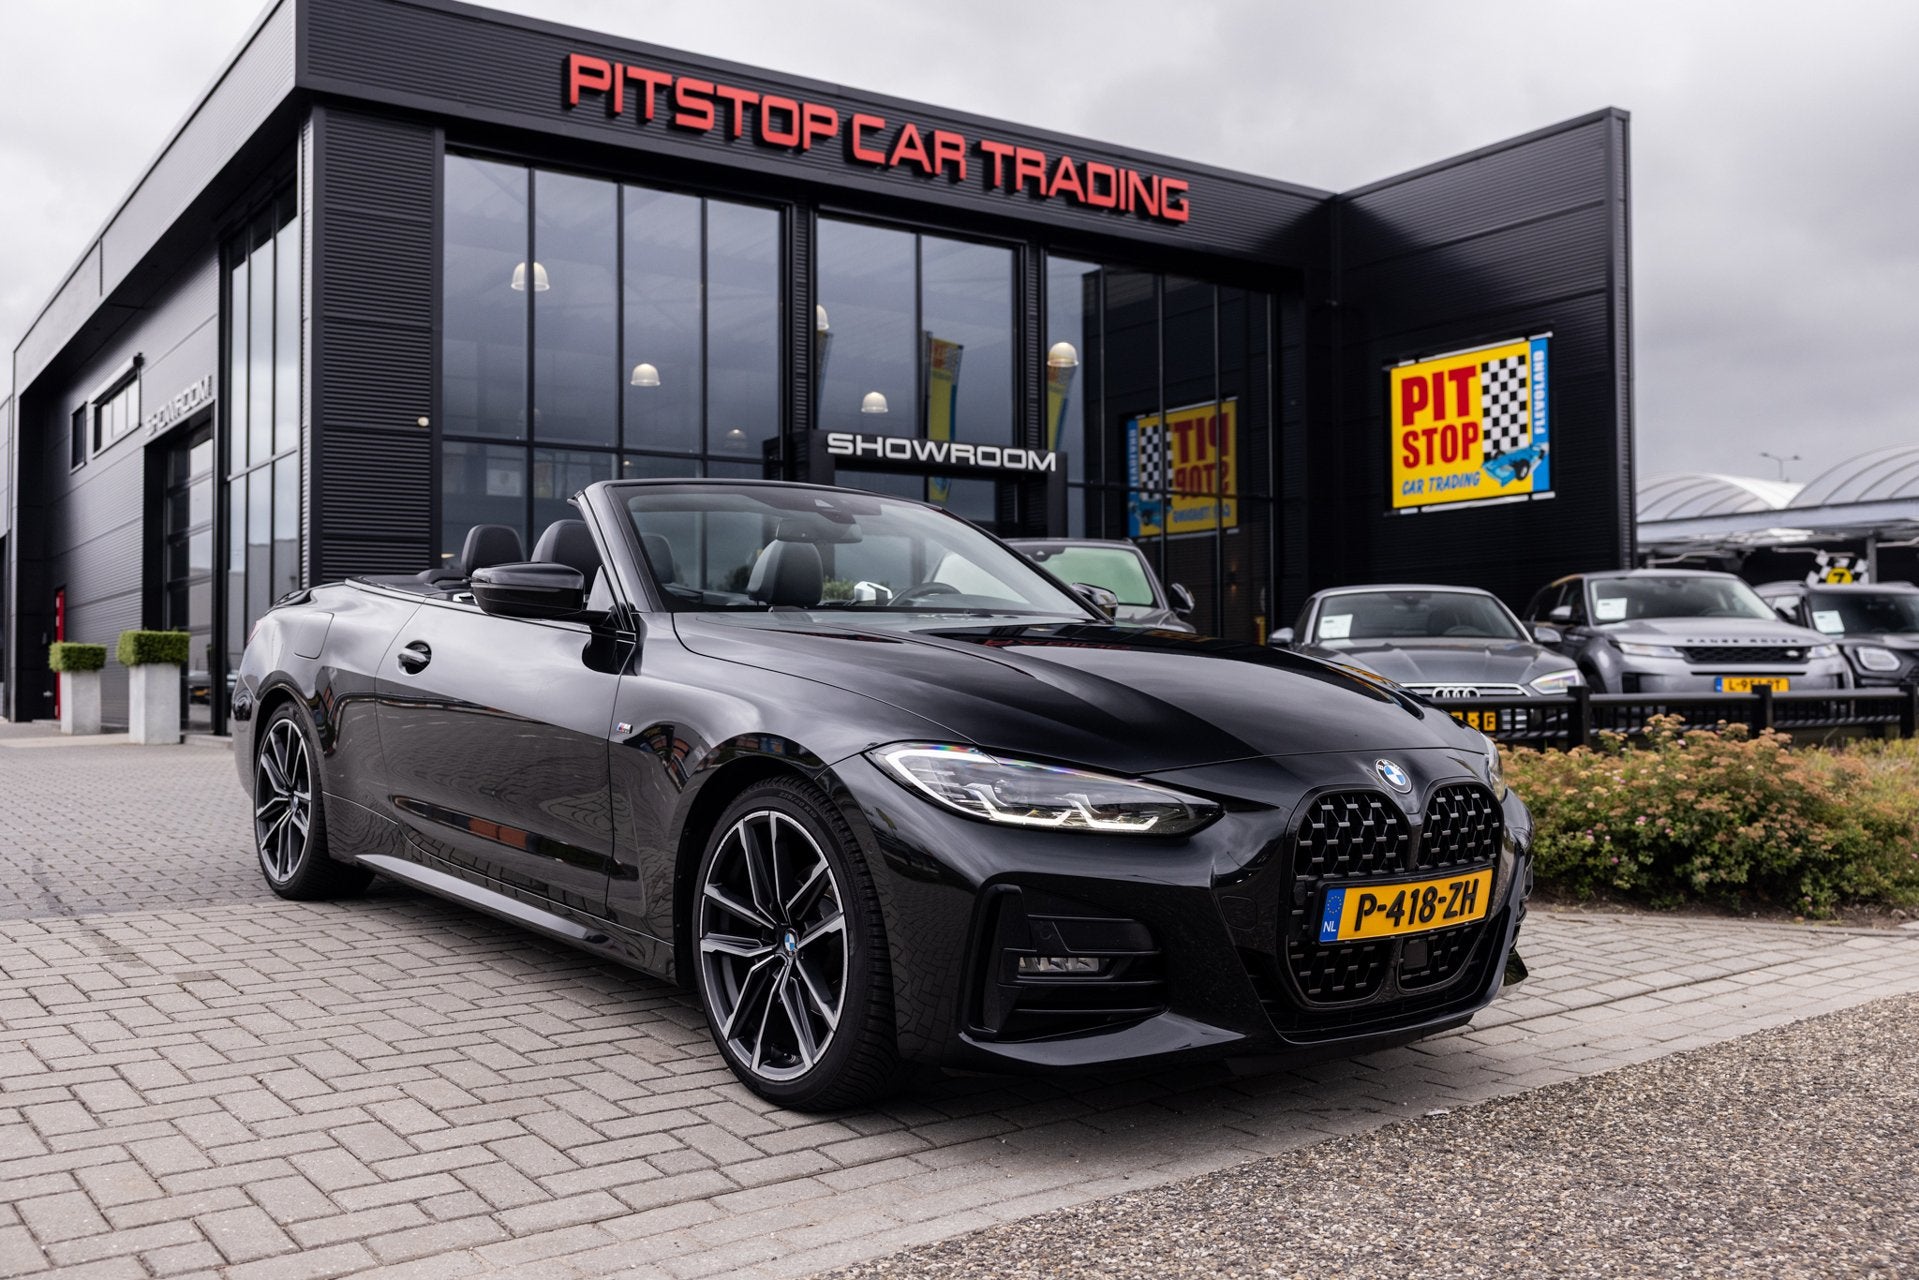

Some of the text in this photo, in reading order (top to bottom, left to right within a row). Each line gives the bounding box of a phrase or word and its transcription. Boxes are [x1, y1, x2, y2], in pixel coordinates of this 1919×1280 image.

[567, 53, 1190, 224] PITSTOP CAR TRADING
[1401, 365, 1477, 427] PIT
[1532, 350, 1546, 435] FLEVOLAND
[826, 432, 1057, 472] SHOWROOM
[1402, 421, 1479, 469] STOP
[1402, 471, 1481, 496] CAR TRADING
[1322, 920, 1337, 933] NL
[1354, 878, 1480, 932] P-418-ZH
